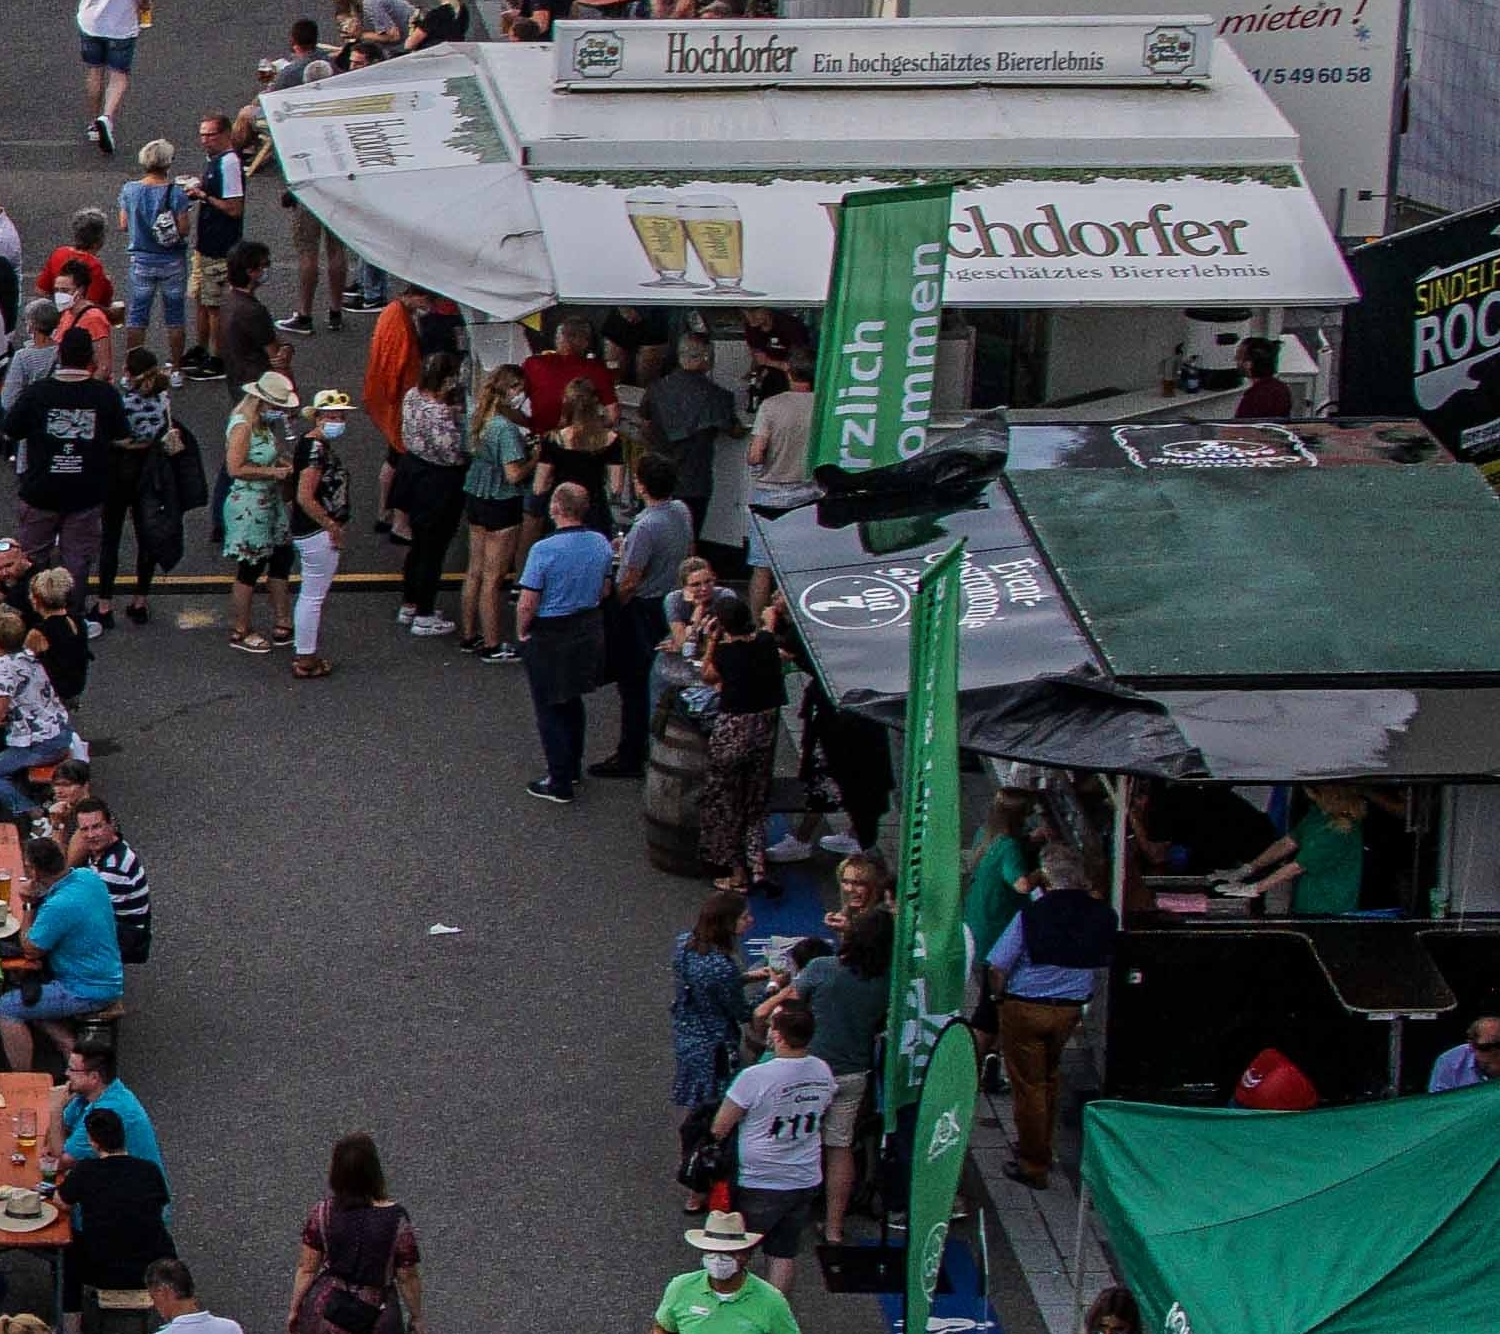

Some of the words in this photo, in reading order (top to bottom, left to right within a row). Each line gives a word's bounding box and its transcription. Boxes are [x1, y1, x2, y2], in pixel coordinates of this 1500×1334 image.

[1217, 3, 1344, 37] mieten
[665, 32, 797, 76] Hochdorfer
[813, 52, 844, 74] Ein
[847, 50, 991, 77] hochgeschätztes
[996, 50, 1104, 73] Biererlebnis
[1109, 263, 1271, 280] Biererlebnis
[840, 319, 887, 467] rzlich
[989, 557, 1052, 607] Event-
